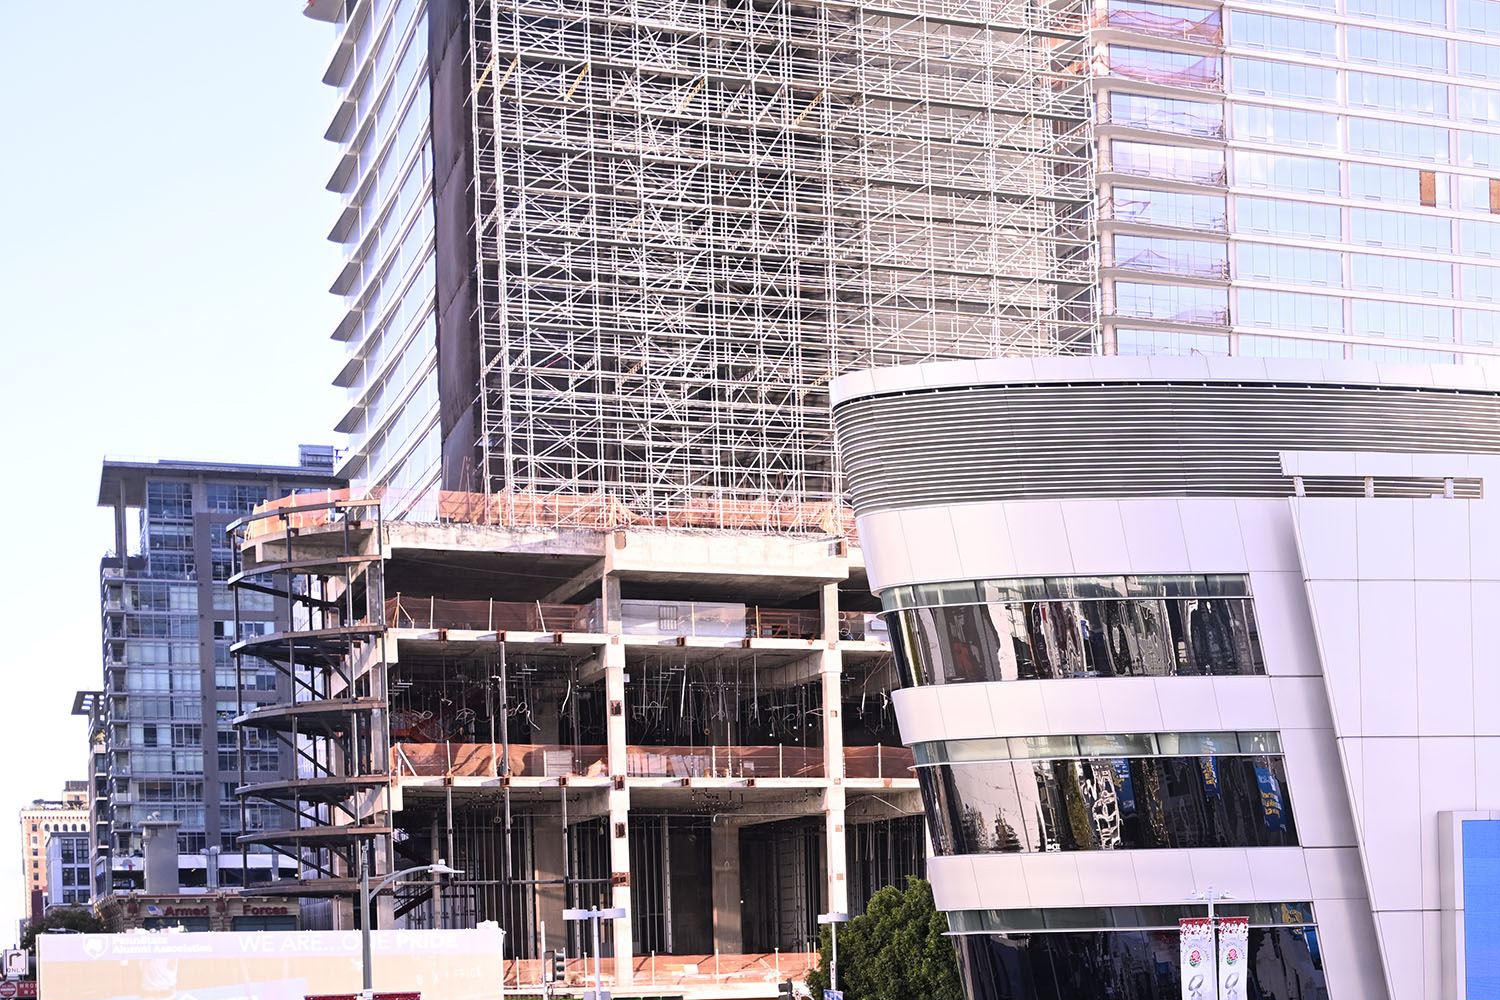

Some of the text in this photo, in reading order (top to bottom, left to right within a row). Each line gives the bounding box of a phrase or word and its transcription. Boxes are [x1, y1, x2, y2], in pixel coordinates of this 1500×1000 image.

[165, 904, 288, 916] Armed Forces
[237, 935, 275, 952] WE
[396, 932, 458, 949] PRIDE
